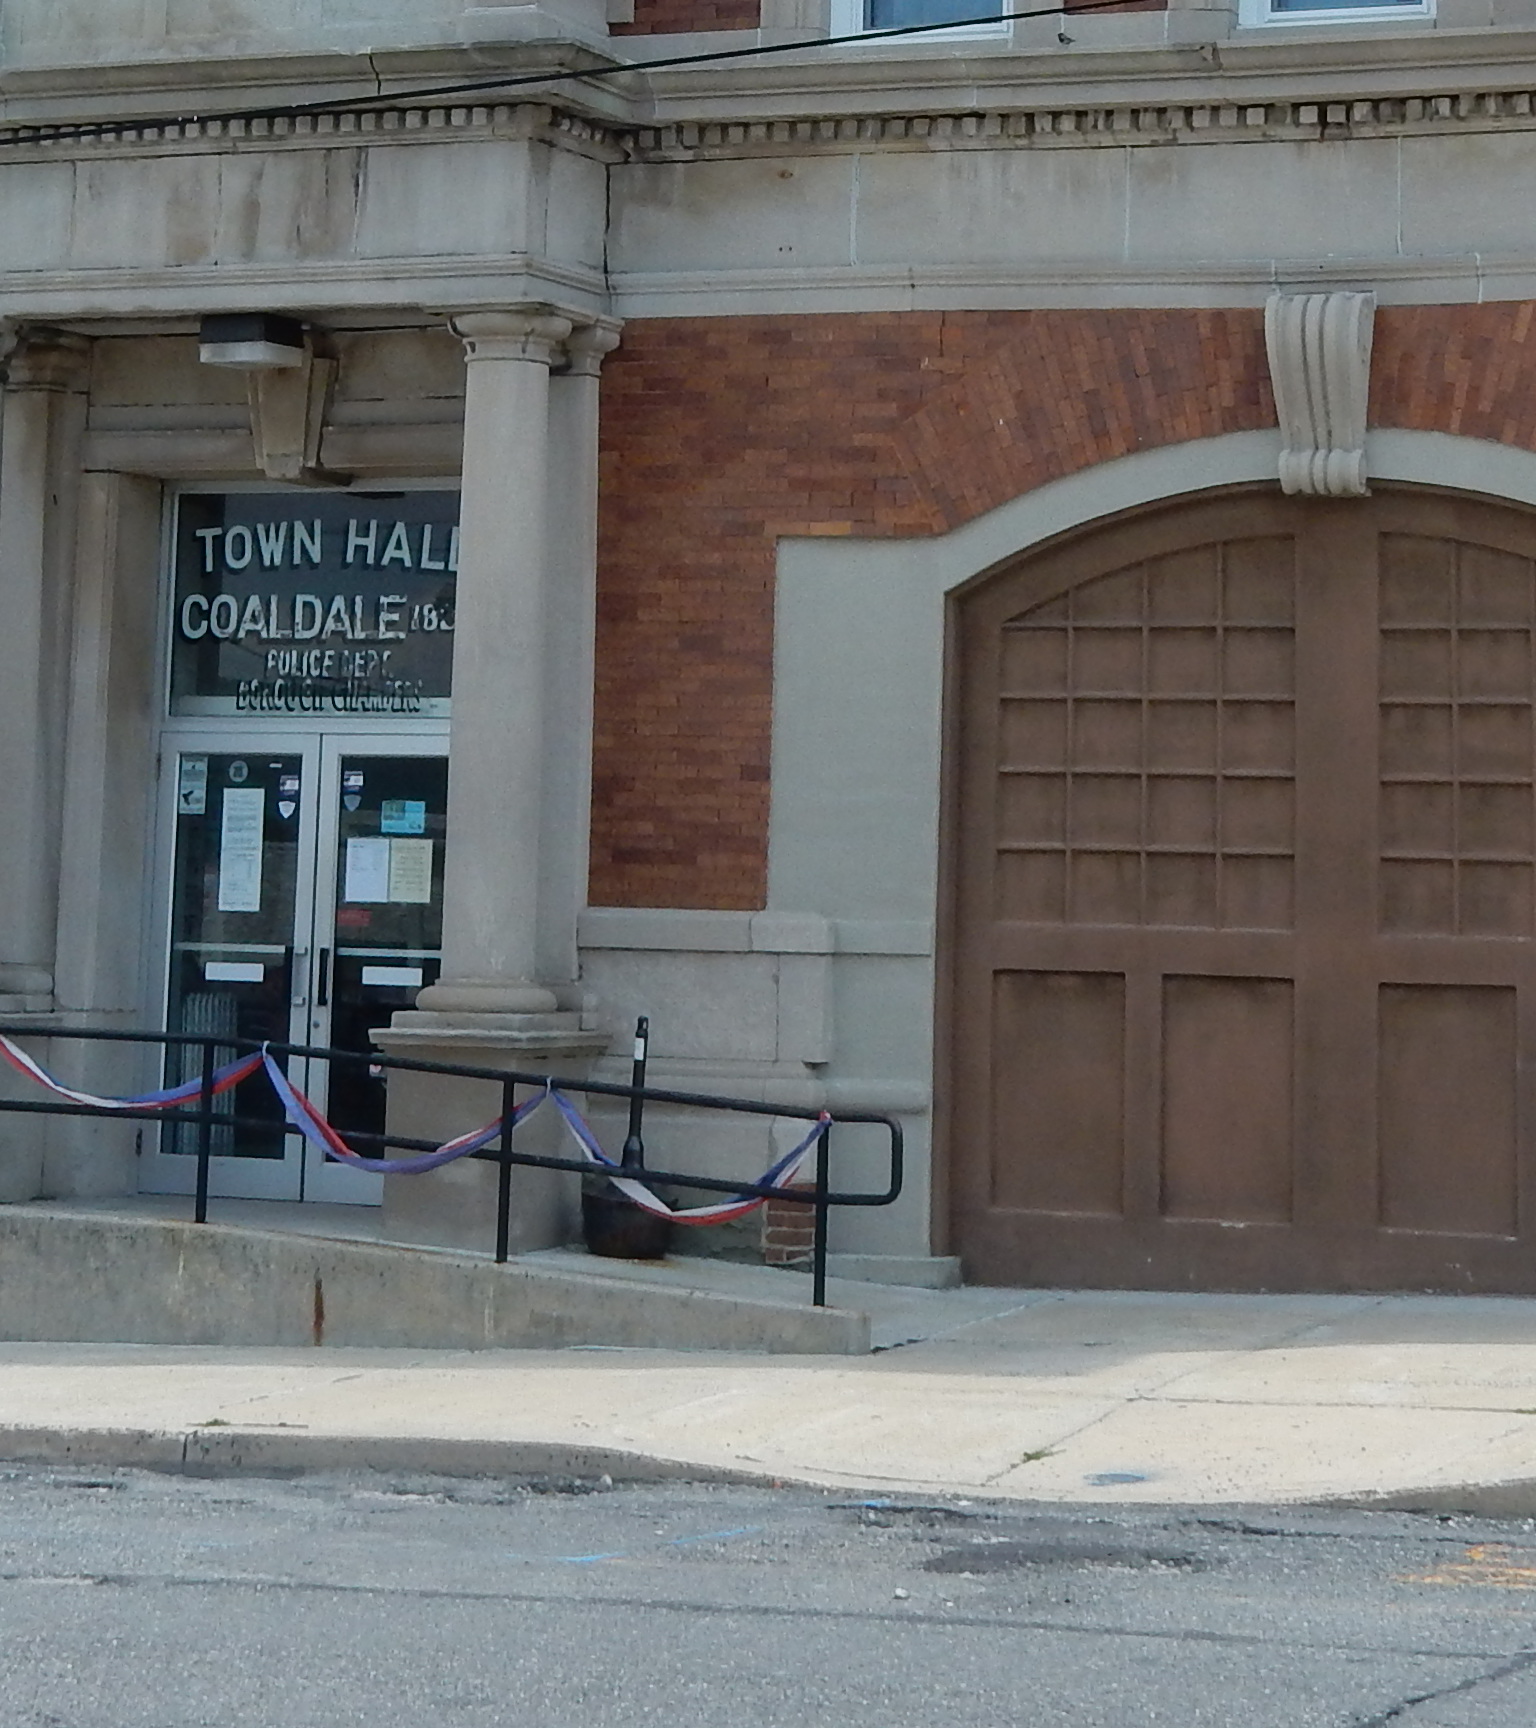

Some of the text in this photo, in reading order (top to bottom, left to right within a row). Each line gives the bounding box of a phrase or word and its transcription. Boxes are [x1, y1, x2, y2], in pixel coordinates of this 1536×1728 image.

[195, 519, 322, 573] TOWN
[181, 593, 409, 640] COALDALE
[267, 648, 336, 679] POLICE
